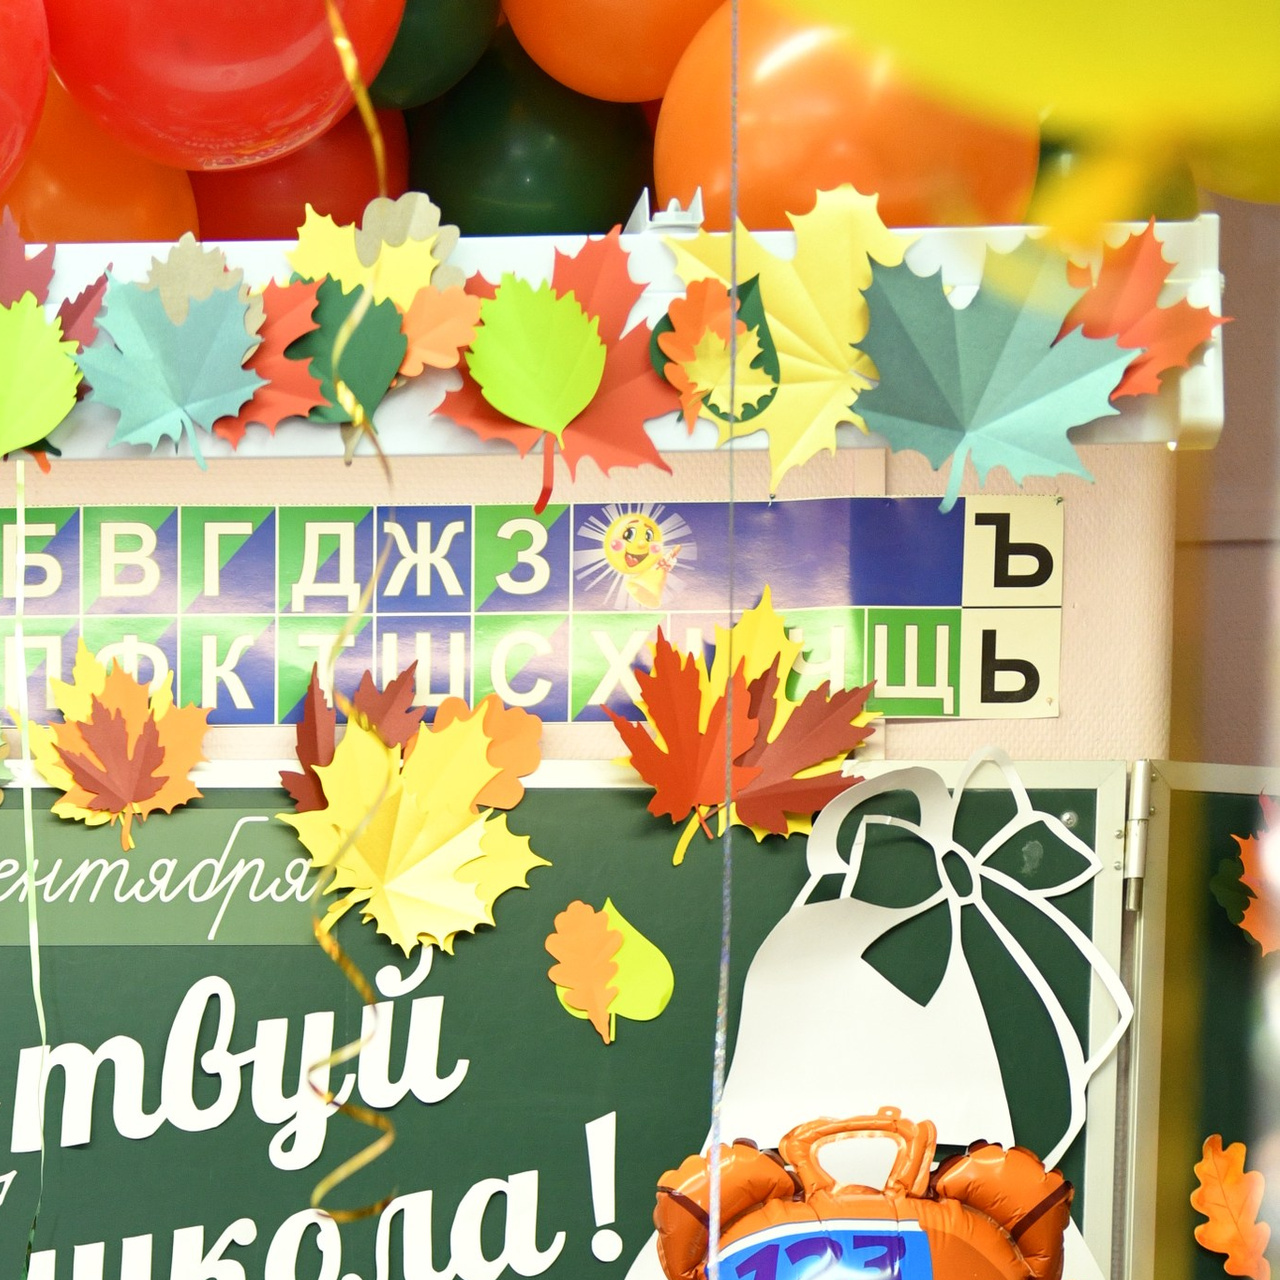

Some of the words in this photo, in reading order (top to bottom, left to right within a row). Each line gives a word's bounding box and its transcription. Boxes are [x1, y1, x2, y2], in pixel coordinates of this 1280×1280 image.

[2, 523, 62, 598] Б
[100, 521, 160, 598] В
[204, 521, 253, 597] Г
[291, 521, 361, 612] Д
[383, 521, 465, 596] Ж
[495, 518, 551, 595] З
[974, 514, 1053, 588] Ъ
[4, 635, 61, 710] П
[202, 635, 255, 710] К
[298, 634, 355, 708] Т
[490, 631, 553, 707] С
[587, 630, 652, 705] Х
[873, 624, 954, 715] Щ
[981, 629, 1040, 703] Ь
